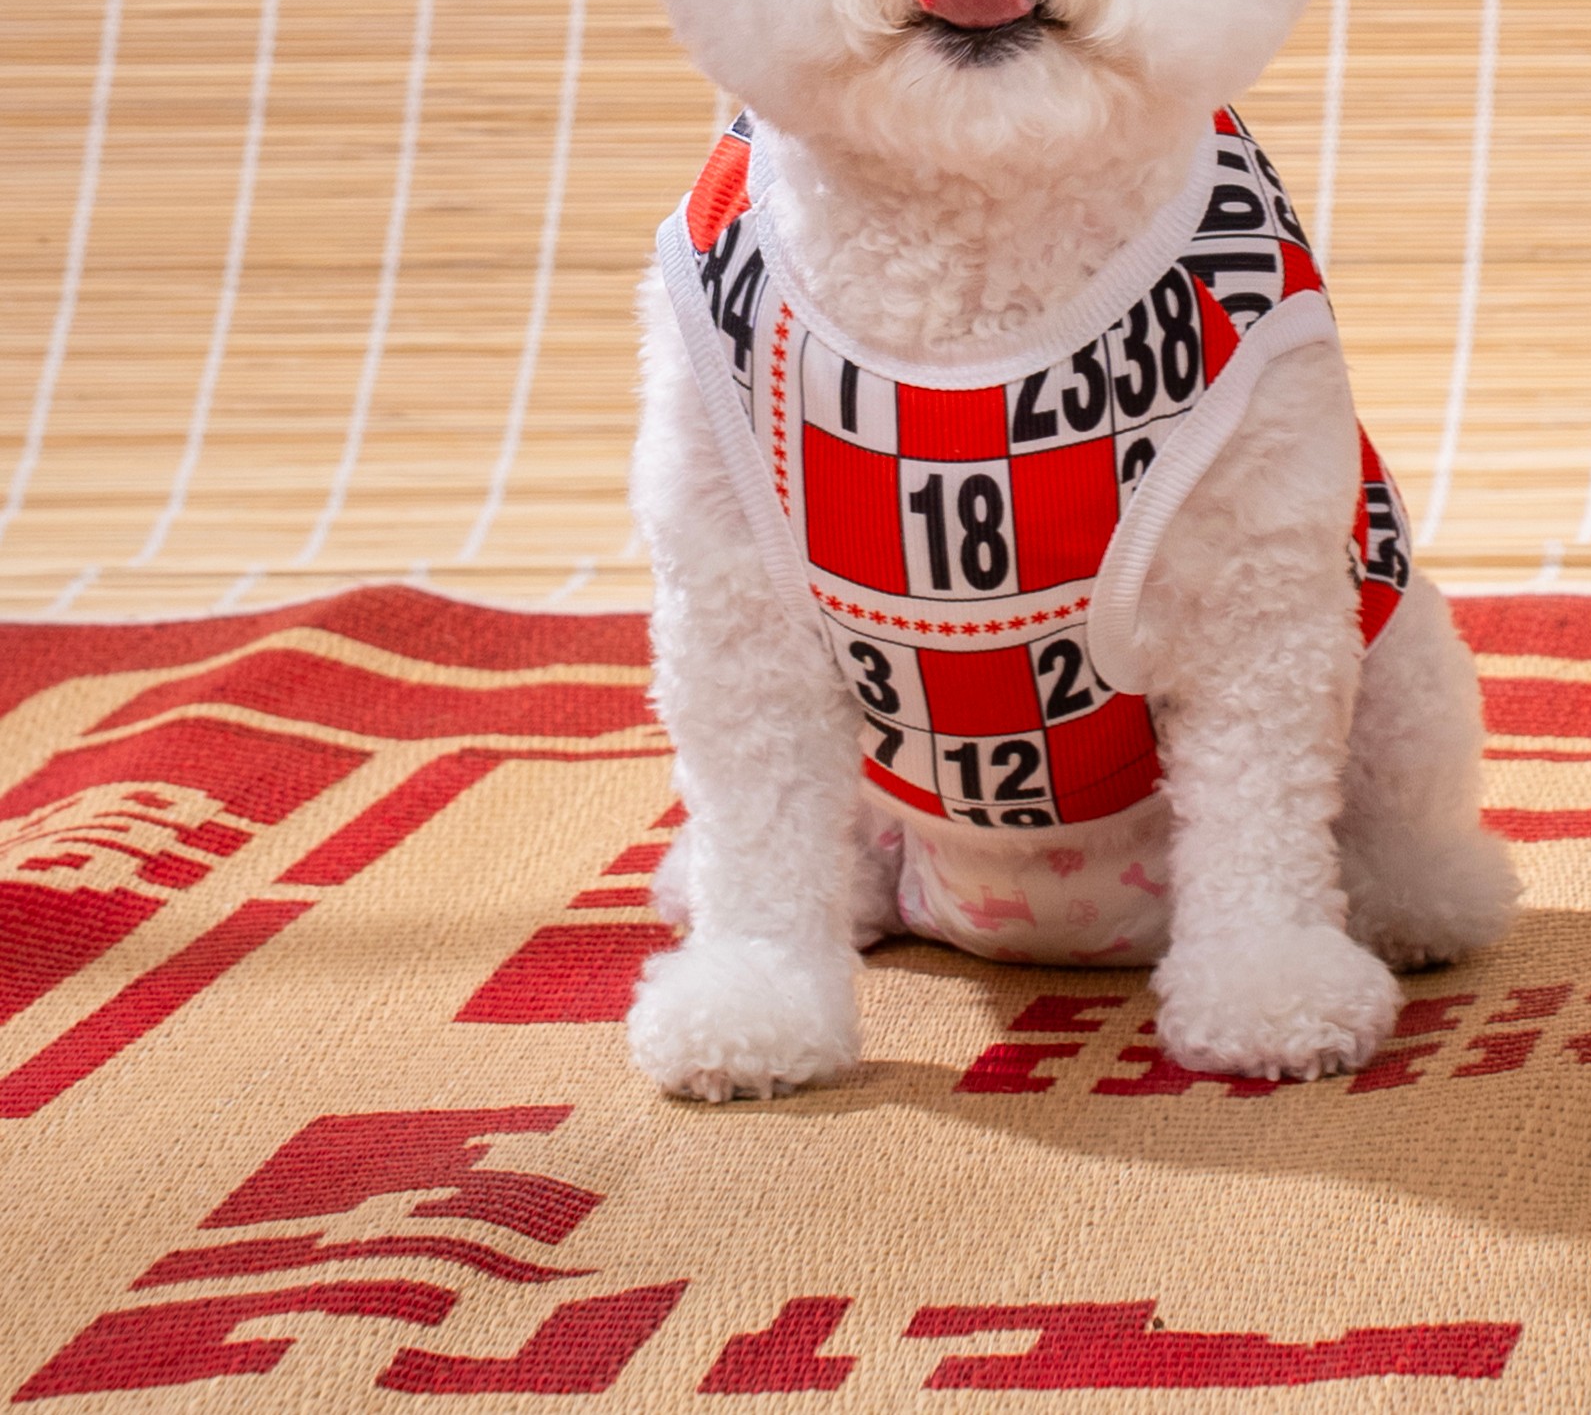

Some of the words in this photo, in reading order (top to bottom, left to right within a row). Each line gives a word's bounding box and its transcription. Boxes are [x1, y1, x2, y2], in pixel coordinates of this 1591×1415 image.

[1012, 343, 1107, 444] 23
[1107, 266, 1201, 419] 38
[909, 473, 1010, 592] 18
[849, 641, 901, 716] 3
[1038, 638, 1113, 720] 2
[944, 739, 1046, 802] 12
